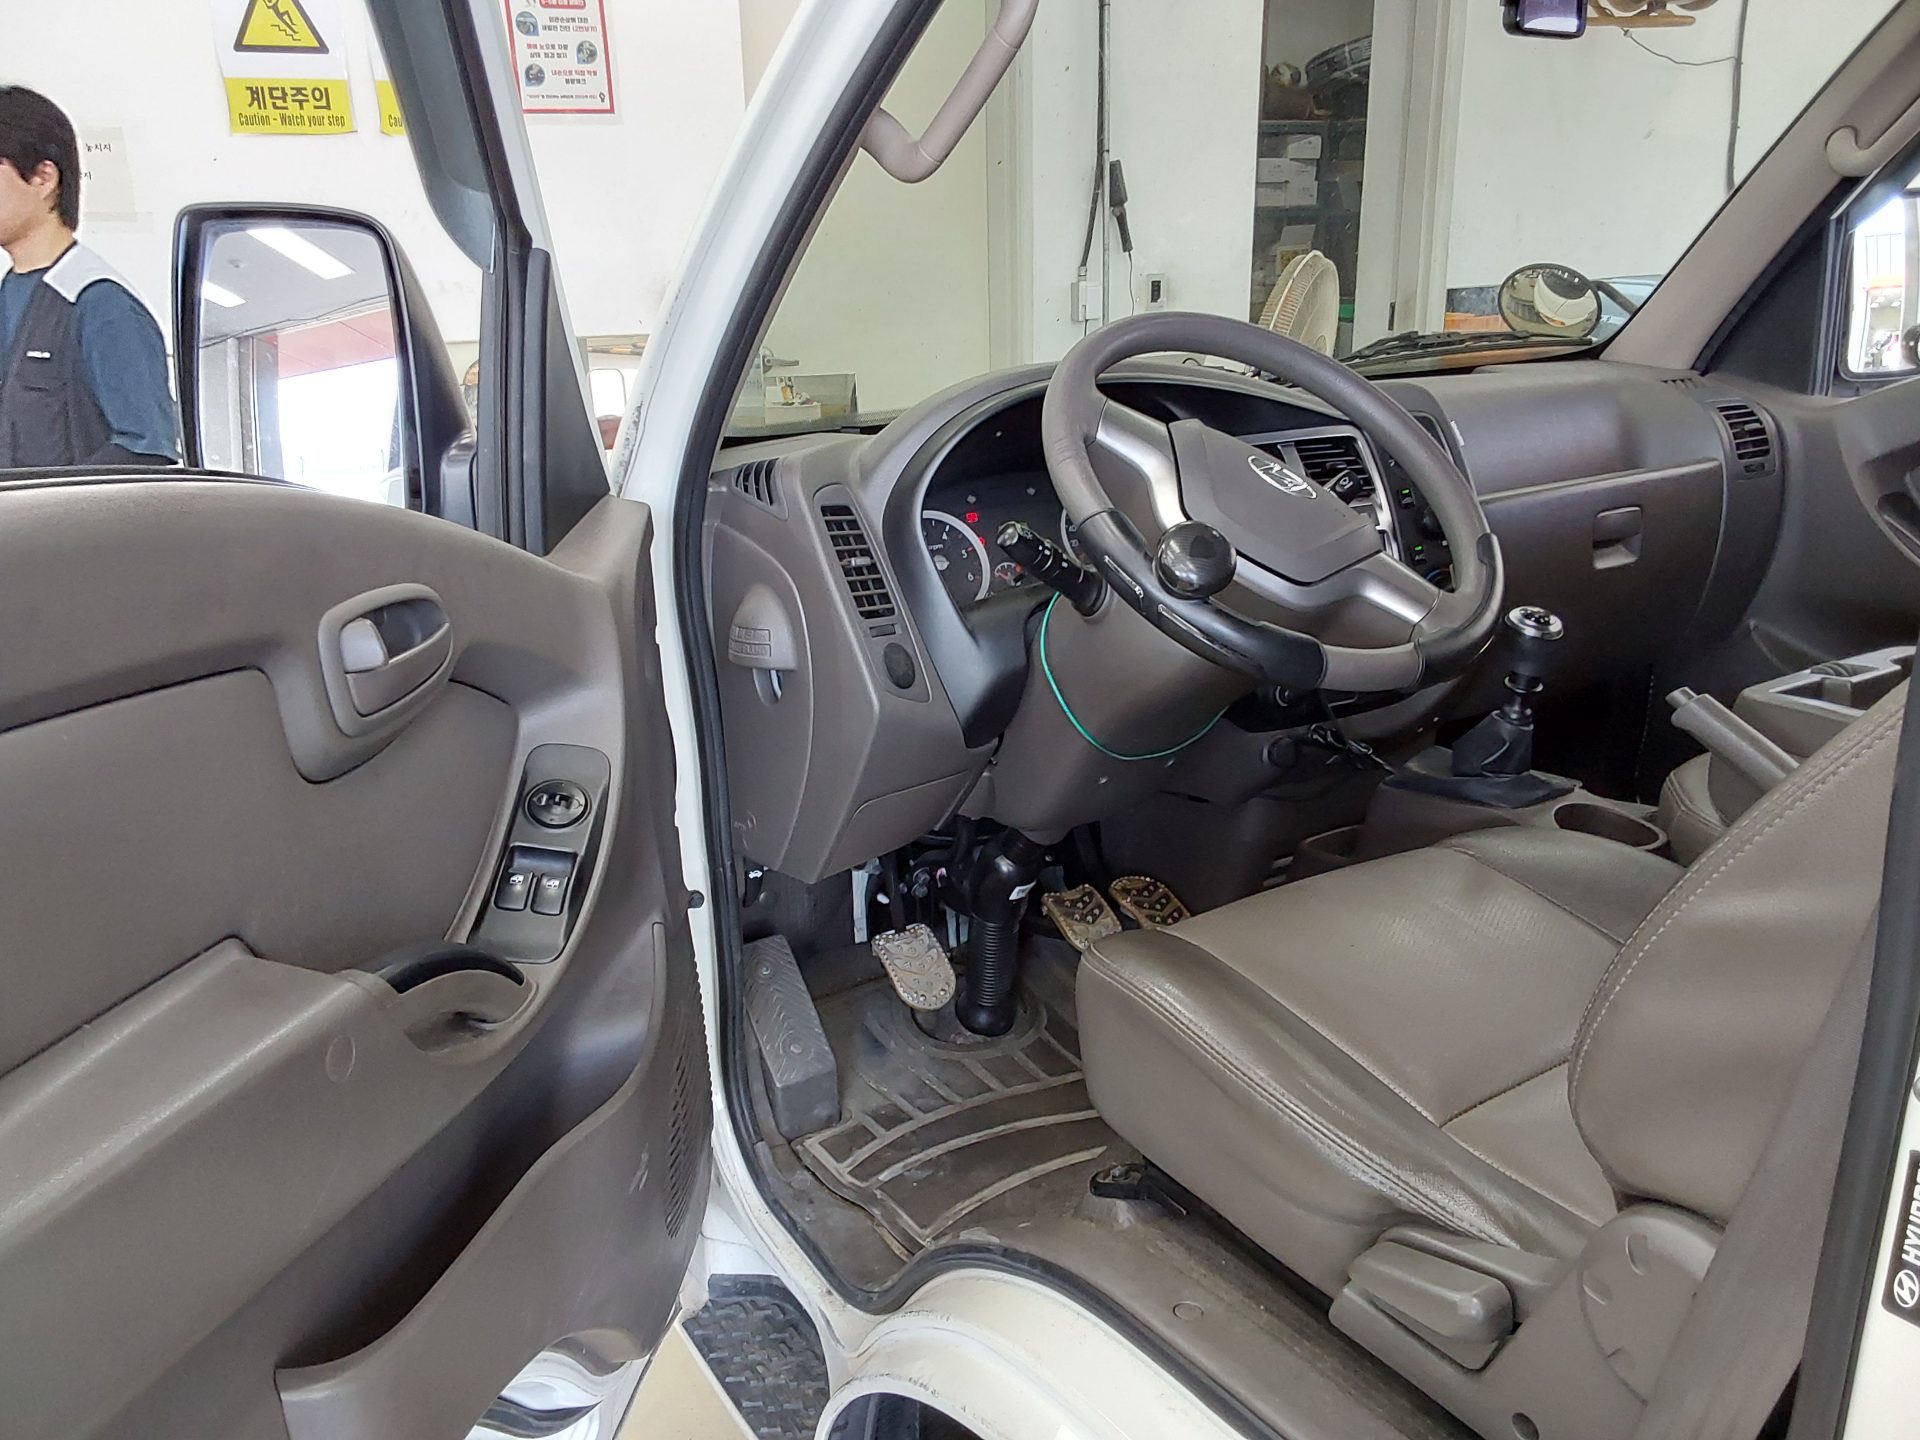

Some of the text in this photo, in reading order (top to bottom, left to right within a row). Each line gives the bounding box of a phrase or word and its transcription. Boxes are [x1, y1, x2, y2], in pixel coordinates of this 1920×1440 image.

[245, 86, 332, 111] 계단주의
[238, 112, 271, 127] Caution
[279, 113, 306, 128] Watch
[308, 114, 325, 128] your
[327, 113, 346, 128] step
[388, 114, 404, 128] Cau
[961, 549, 968, 559] 5
[968, 571, 975, 581] 6
